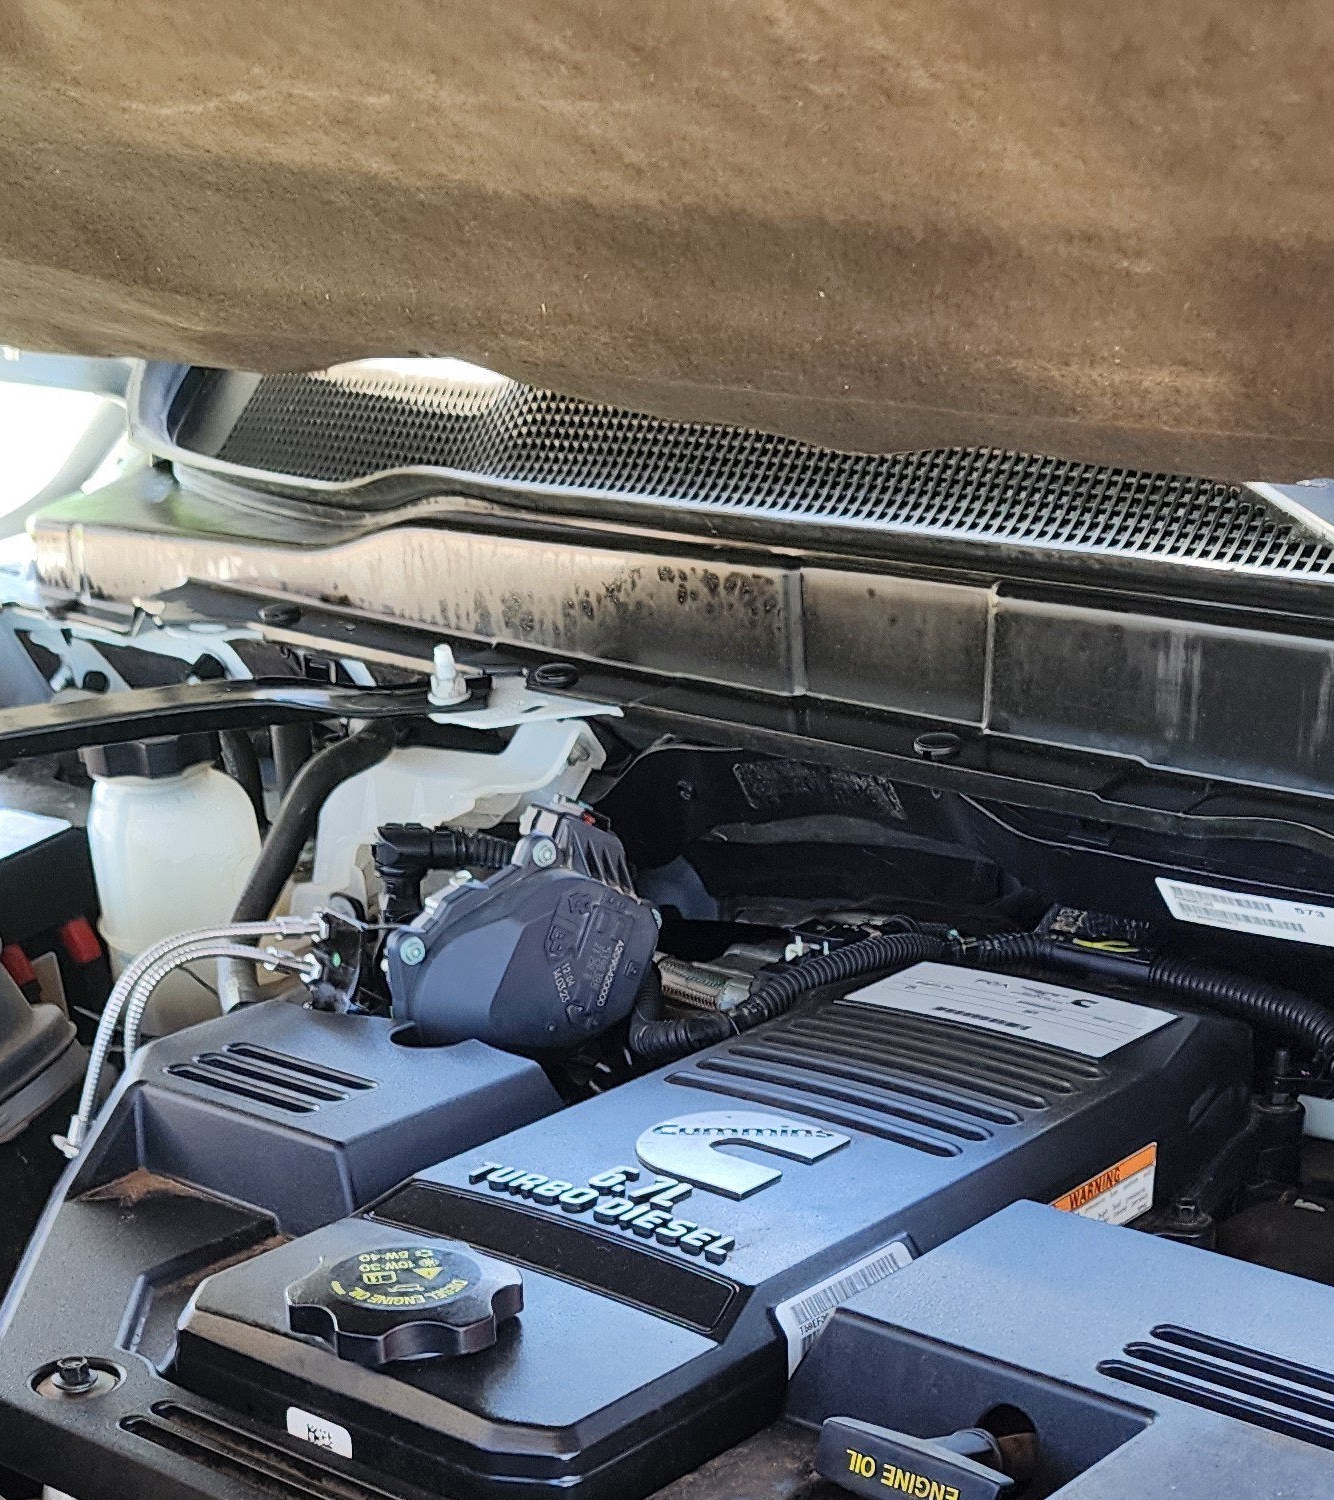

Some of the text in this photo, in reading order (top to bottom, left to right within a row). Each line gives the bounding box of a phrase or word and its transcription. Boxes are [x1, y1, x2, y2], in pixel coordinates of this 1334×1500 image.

[588, 1165, 694, 1212] 6.7L
[1069, 1166, 1121, 1210] WARNING
[469, 1161, 736, 1265] TURBO DIESEL
[370, 1292, 425, 1306] ENGINE
[846, 1448, 877, 1479] OIL
